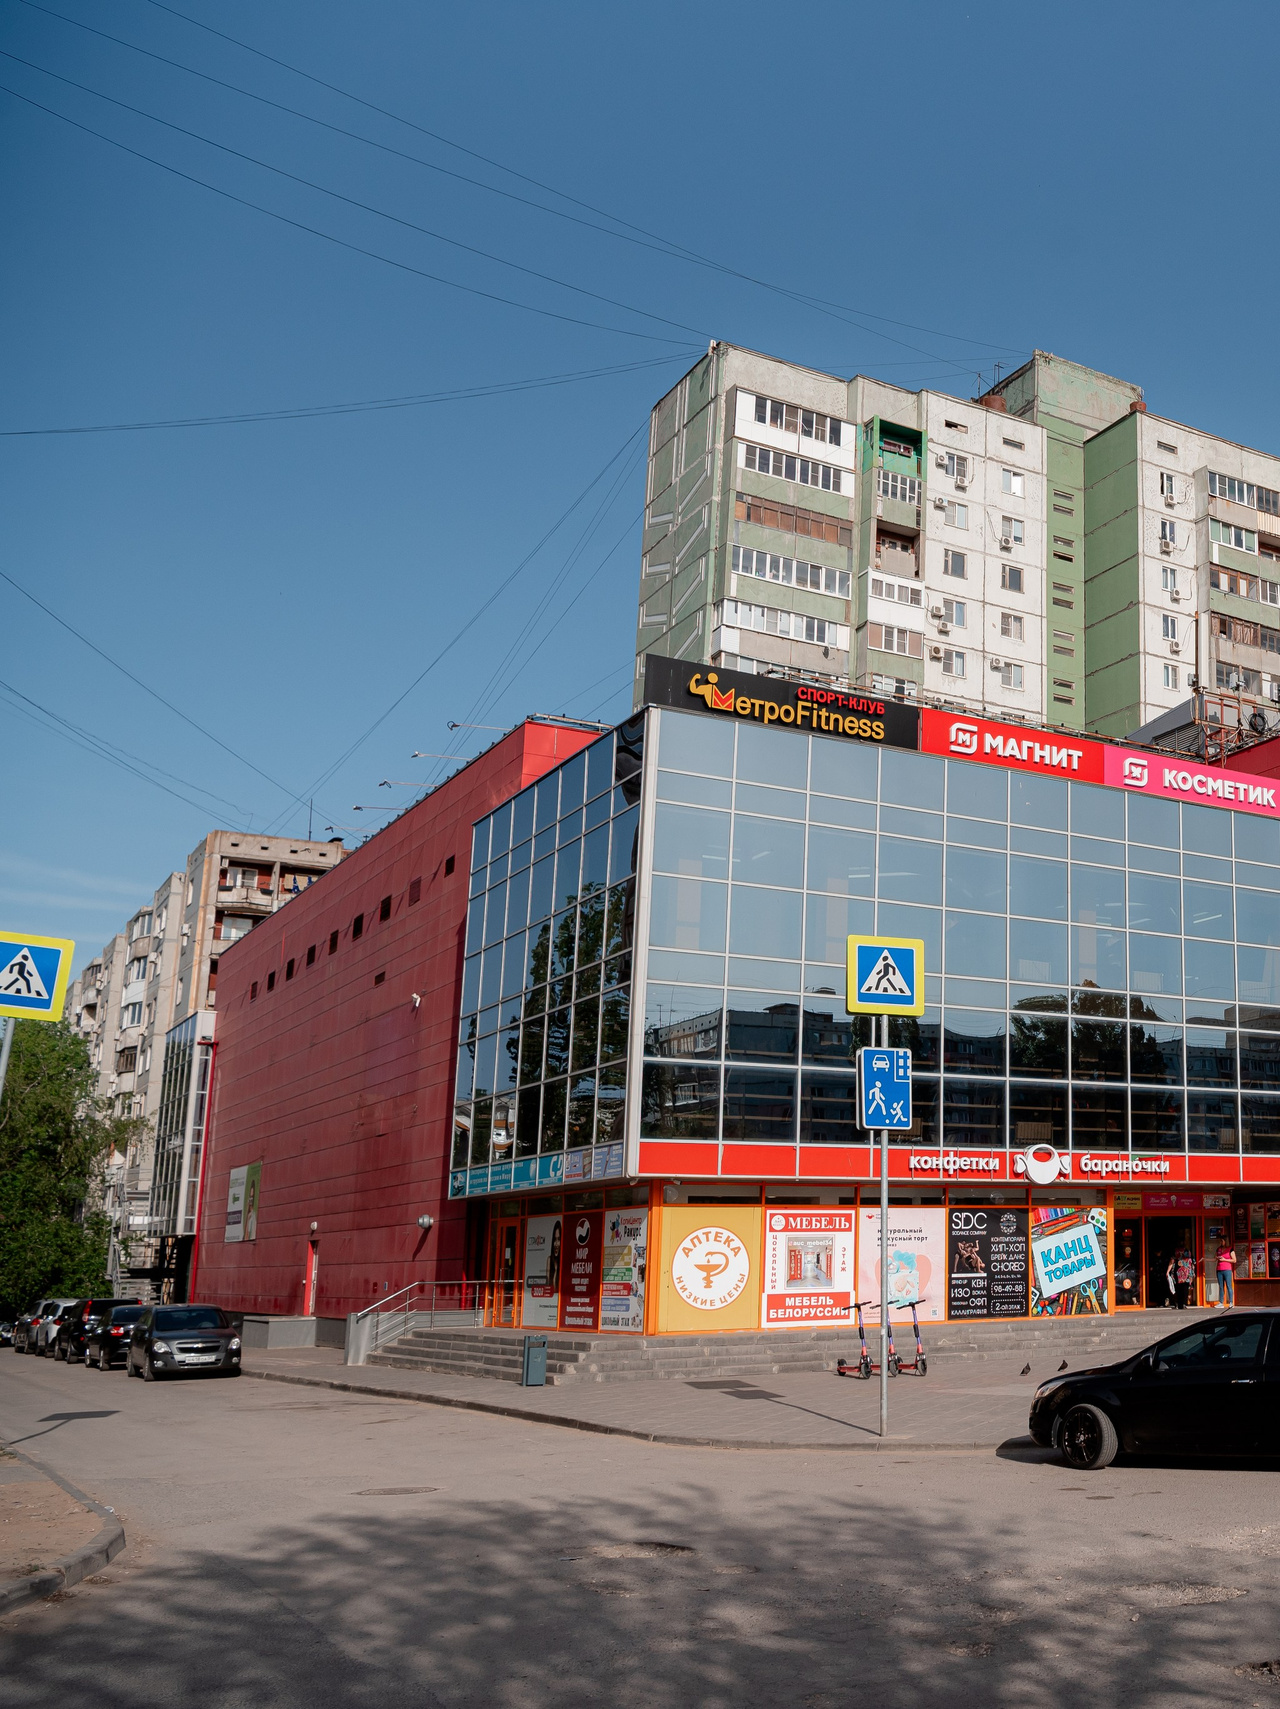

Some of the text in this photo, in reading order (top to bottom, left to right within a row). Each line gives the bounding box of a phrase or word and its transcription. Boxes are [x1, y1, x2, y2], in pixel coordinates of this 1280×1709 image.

[797, 686, 886, 715] СПОРТ-КЛУБ
[983, 732, 1083, 771] МАГНИТ
[1162, 768, 1277, 808] КОСМЕТИК
[908, 1153, 1170, 1176] конфетки бараночки
[788, 1217, 850, 1229] МЕБЕЛЬ
[952, 1212, 987, 1229] SDC
[681, 1231, 742, 1258] АПТЕКА
[991, 1243, 1025, 1252] ХИП-ХОП
[1040, 1234, 1094, 1268] КАНЦ
[575, 1247, 589, 1260] МИР
[571, 1262, 593, 1274] МЕБЕЛИ
[991, 1262, 1025, 1271] CHOREO
[1044, 1253, 1096, 1283] ТОВАРЫ
[676, 1273, 746, 1307] НИЗКИЕ ЦЕНЫ
[971, 1279, 987, 1288] КВН
[951, 1287, 971, 1298] ИЗО
[785, 1296, 834, 1306] МЕБЕЛЬ
[969, 1297, 987, 1306] ОФП
[769, 1307, 849, 1319] БЕЛОРУССИИ
